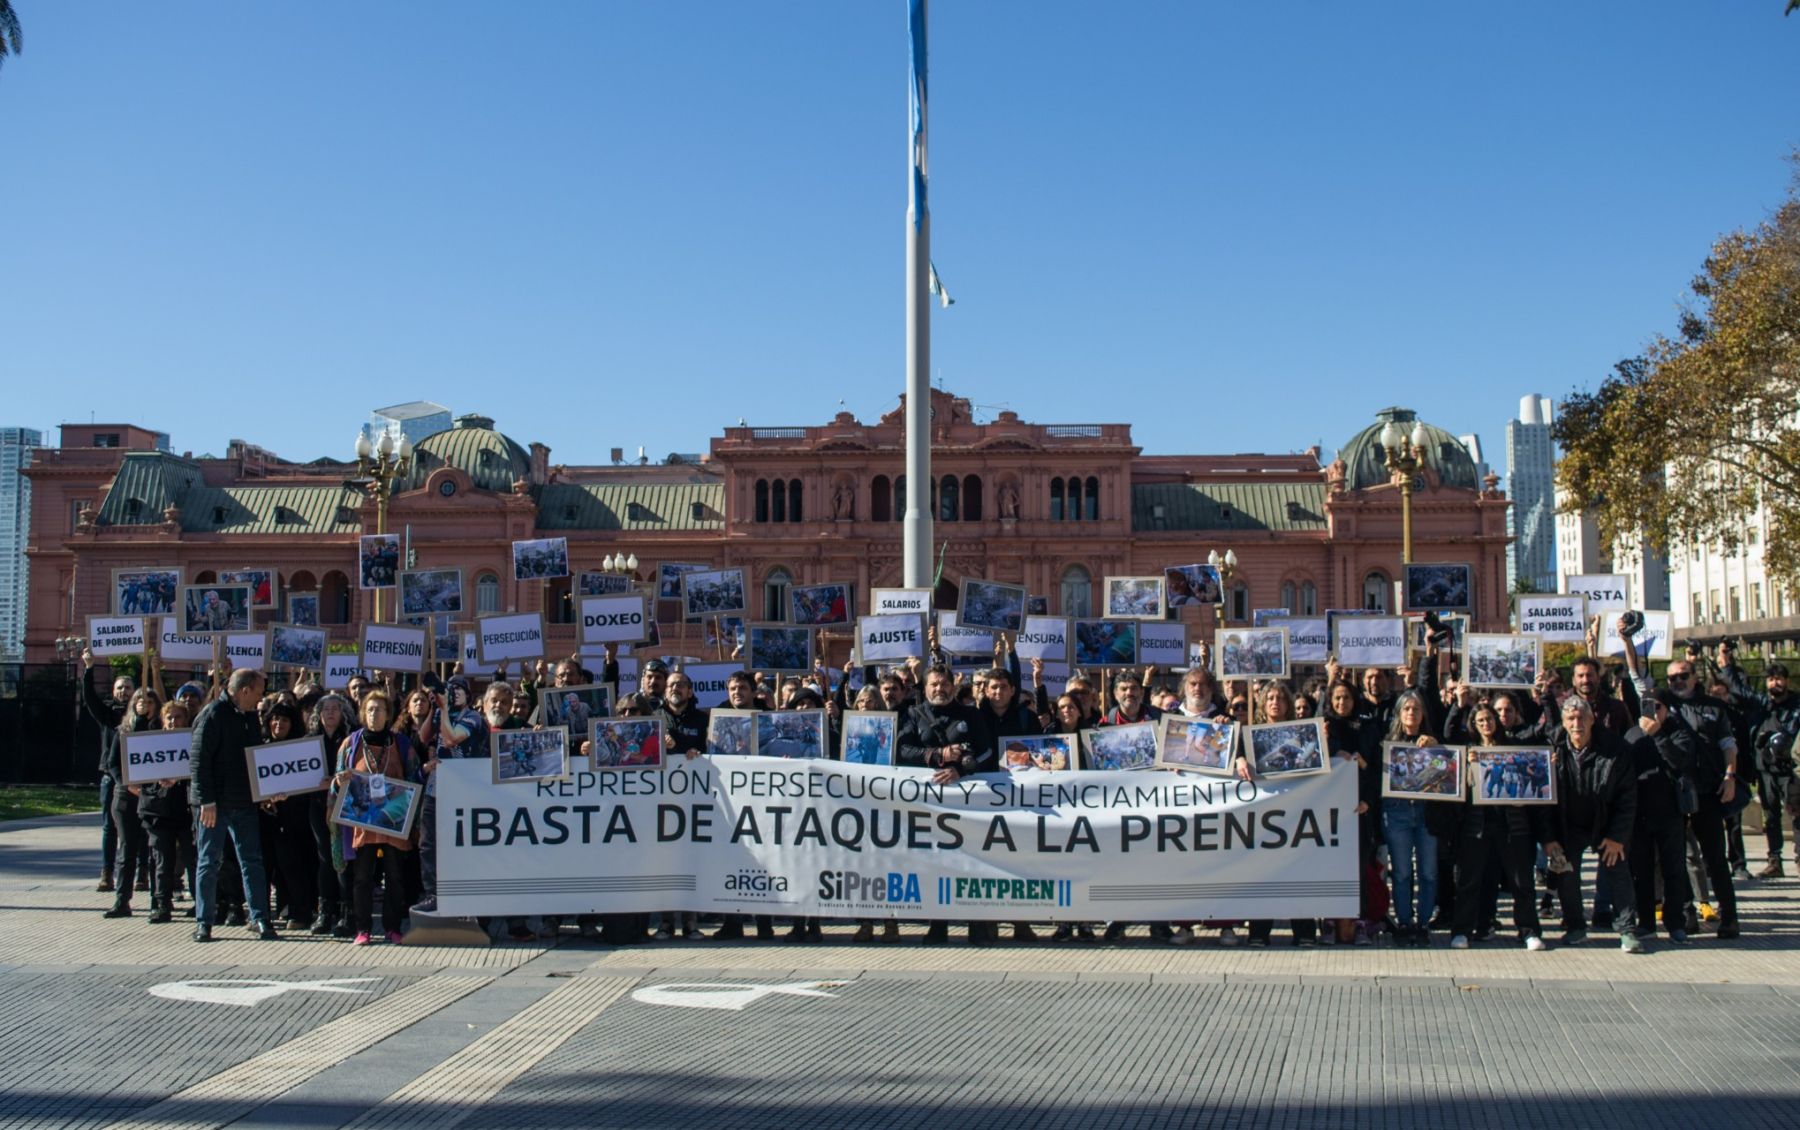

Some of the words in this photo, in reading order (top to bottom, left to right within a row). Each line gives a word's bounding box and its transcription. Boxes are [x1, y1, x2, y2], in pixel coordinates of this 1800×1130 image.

[882, 599, 921, 609] SALARIOS
[1528, 607, 1573, 618] SALARIOS
[584, 612, 642, 627] DOXEO
[96, 624, 135, 635] SALARIOS
[1522, 621, 1534, 632] DE
[1539, 621, 1583, 632] POBREZA
[92, 638, 103, 648] DE
[106, 636, 143, 647] POBREZA
[163, 632, 219, 646] CENSUR
[483, 629, 541, 645] PERSECUCIÓN
[868, 630, 916, 645] AJUSTE
[1018, 632, 1065, 645] ENSURA
[1139, 636, 1184, 649] RSECUCIÓN
[1289, 634, 1326, 646] GAMIENTO
[1341, 636, 1402, 648] SILENCIAMIENTO
[226, 645, 263, 657] OLENCIA
[365, 639, 422, 657] REPRESIÓN
[692, 680, 727, 692] IOLEN
[129, 748, 190, 766] BASTA
[257, 756, 322, 779] DOXEO
[536, 764, 718, 799] REPRESIÓN,
[731, 770, 944, 805] PERSECUCIÓN
[959, 781, 978, 805] Y
[990, 780, 1258, 808] SILENCIAMIENTO
[455, 804, 637, 847] ¡BASTA
[656, 803, 713, 843] DE
[730, 805, 964, 851] ATAQUES
[982, 814, 1018, 852] A
[1037, 814, 1101, 854] LA
[1120, 807, 1340, 854] PRENSA!
[818, 870, 922, 903] SiPreBA
[955, 877, 1055, 900] FATPREN
